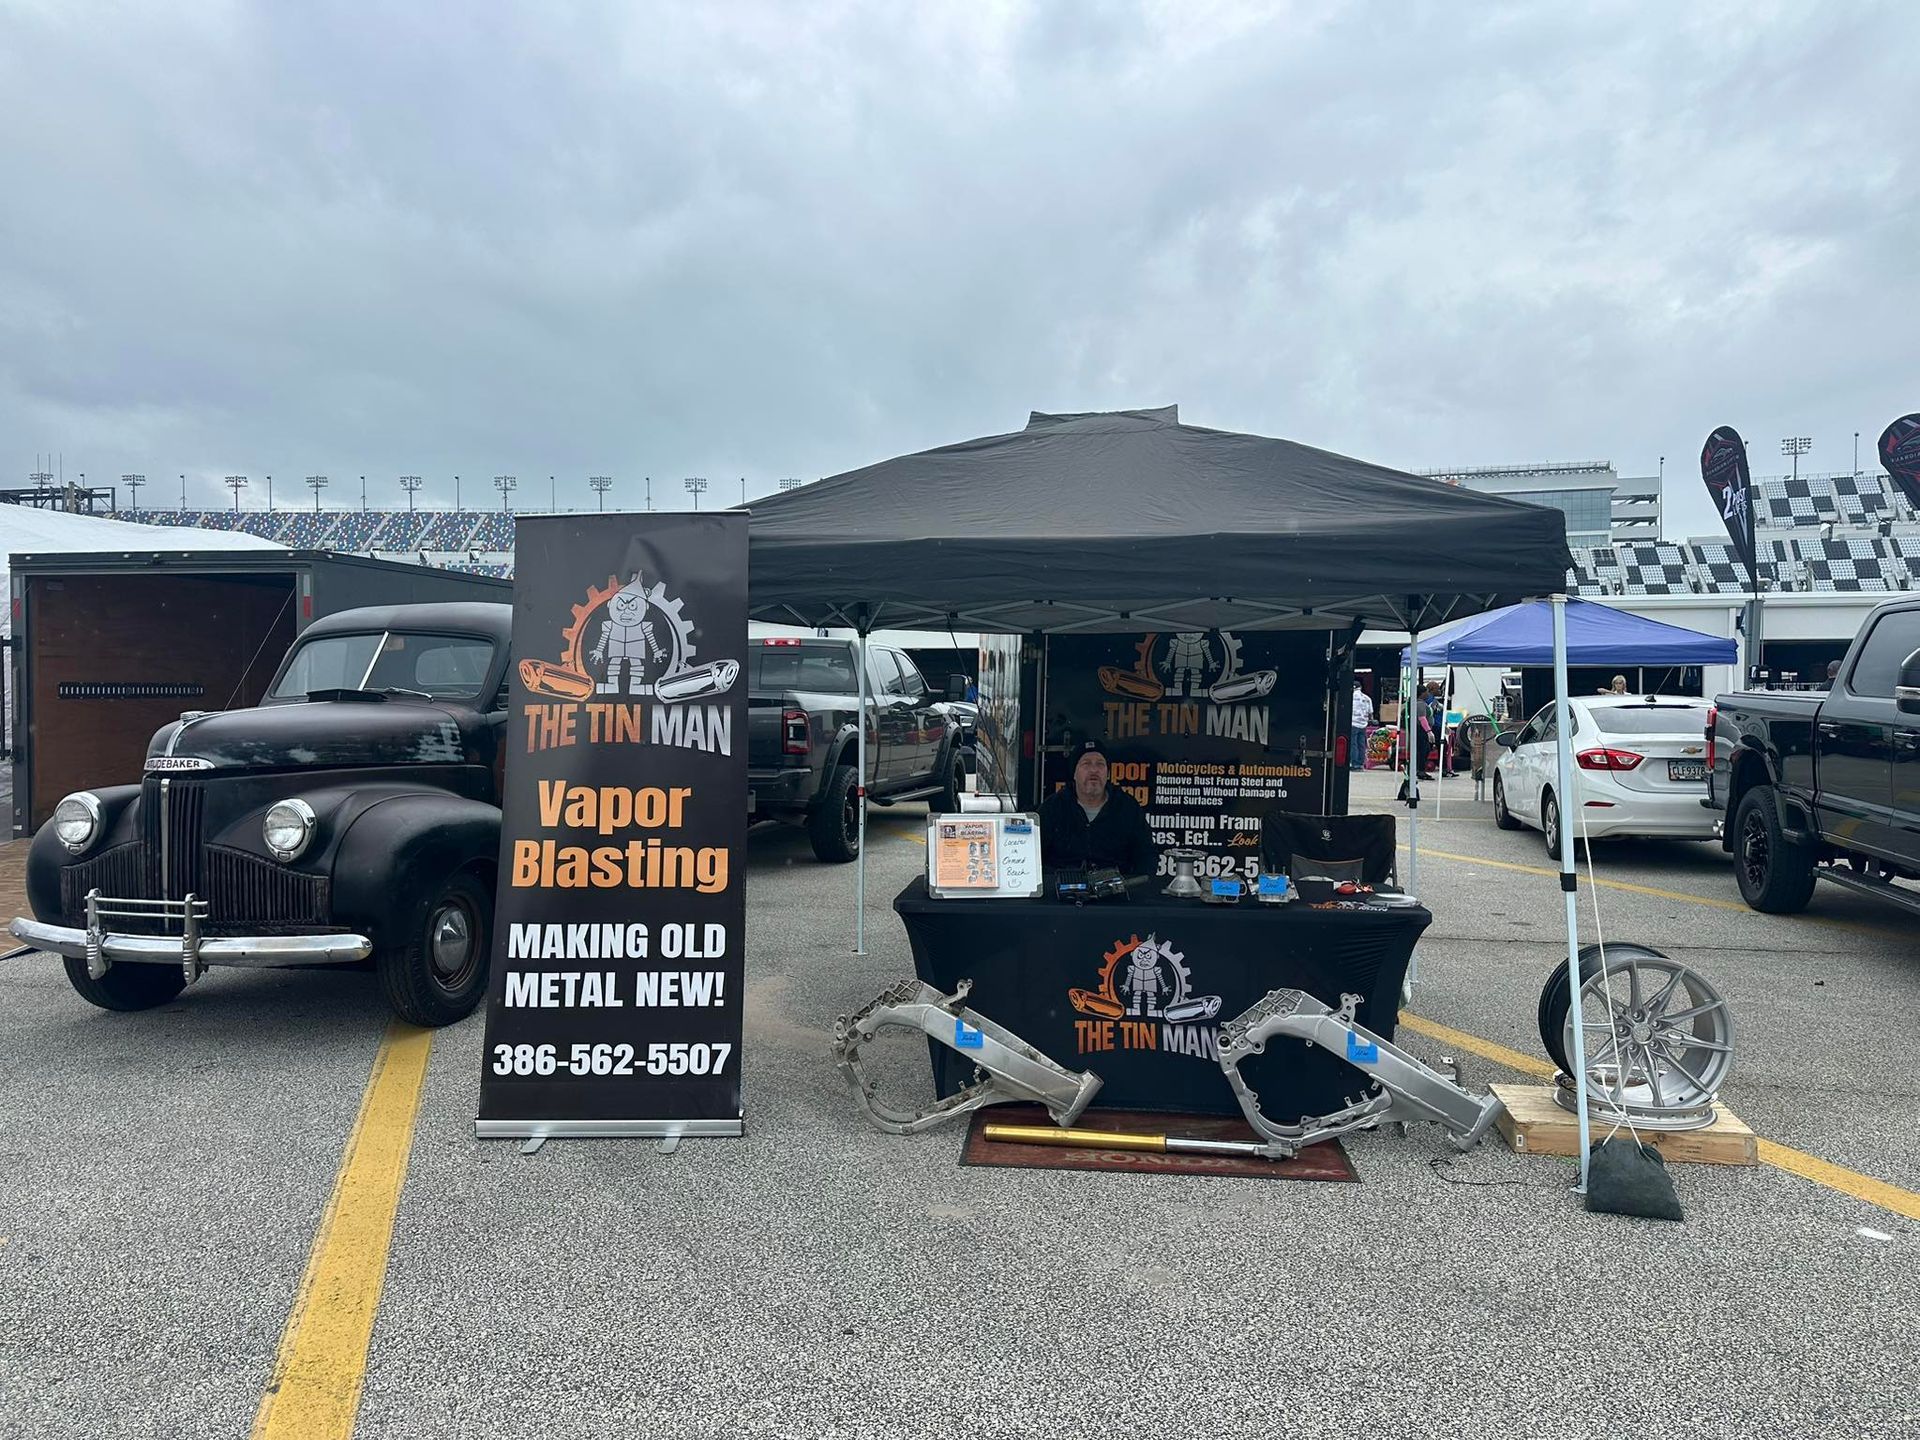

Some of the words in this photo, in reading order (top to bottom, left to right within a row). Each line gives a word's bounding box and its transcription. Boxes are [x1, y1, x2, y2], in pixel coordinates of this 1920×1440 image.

[1722, 486, 1733, 520] 2
[524, 704, 577, 753] THE
[585, 704, 641, 743] TIN
[651, 705, 731, 757] MAN
[1103, 702, 1151, 741] THE
[1157, 703, 1199, 735] TIN
[1206, 704, 1269, 746] MAN
[147, 759, 200, 769] STUDEBAKER
[1156, 763, 1225, 776] Motocycles
[1228, 764, 1235, 775] &
[1238, 764, 1312, 777] Automobiles
[1156, 775, 1192, 785] Remove
[1194, 776, 1214, 785] Rust
[1216, 776, 1239, 786] From
[1241, 777, 1264, 787] Steel
[1266, 778, 1283, 787] and
[1156, 786, 1200, 796] Aluminum
[1203, 787, 1237, 797] Without
[1240, 788, 1276, 799] Damage
[1278, 789, 1288, 798] to
[537, 780, 691, 835] Vapor
[1155, 795, 1181, 805] Metal
[1183, 796, 1223, 806] Surfaces
[1184, 831, 1223, 846] Ect...
[1227, 832, 1260, 847] Look
[1219, 815, 1262, 830] Fram
[511, 839, 729, 893] Blasting
[508, 924, 648, 959] MAKING
[661, 924, 726, 958] OLD
[504, 972, 623, 1008] METAL
[636, 972, 725, 1007] NEW!
[1074, 1020, 1115, 1055] THE
[1119, 1021, 1157, 1050] TIN
[1162, 1024, 1219, 1062] MAN
[493, 1043, 732, 1076] 386-562-5507
